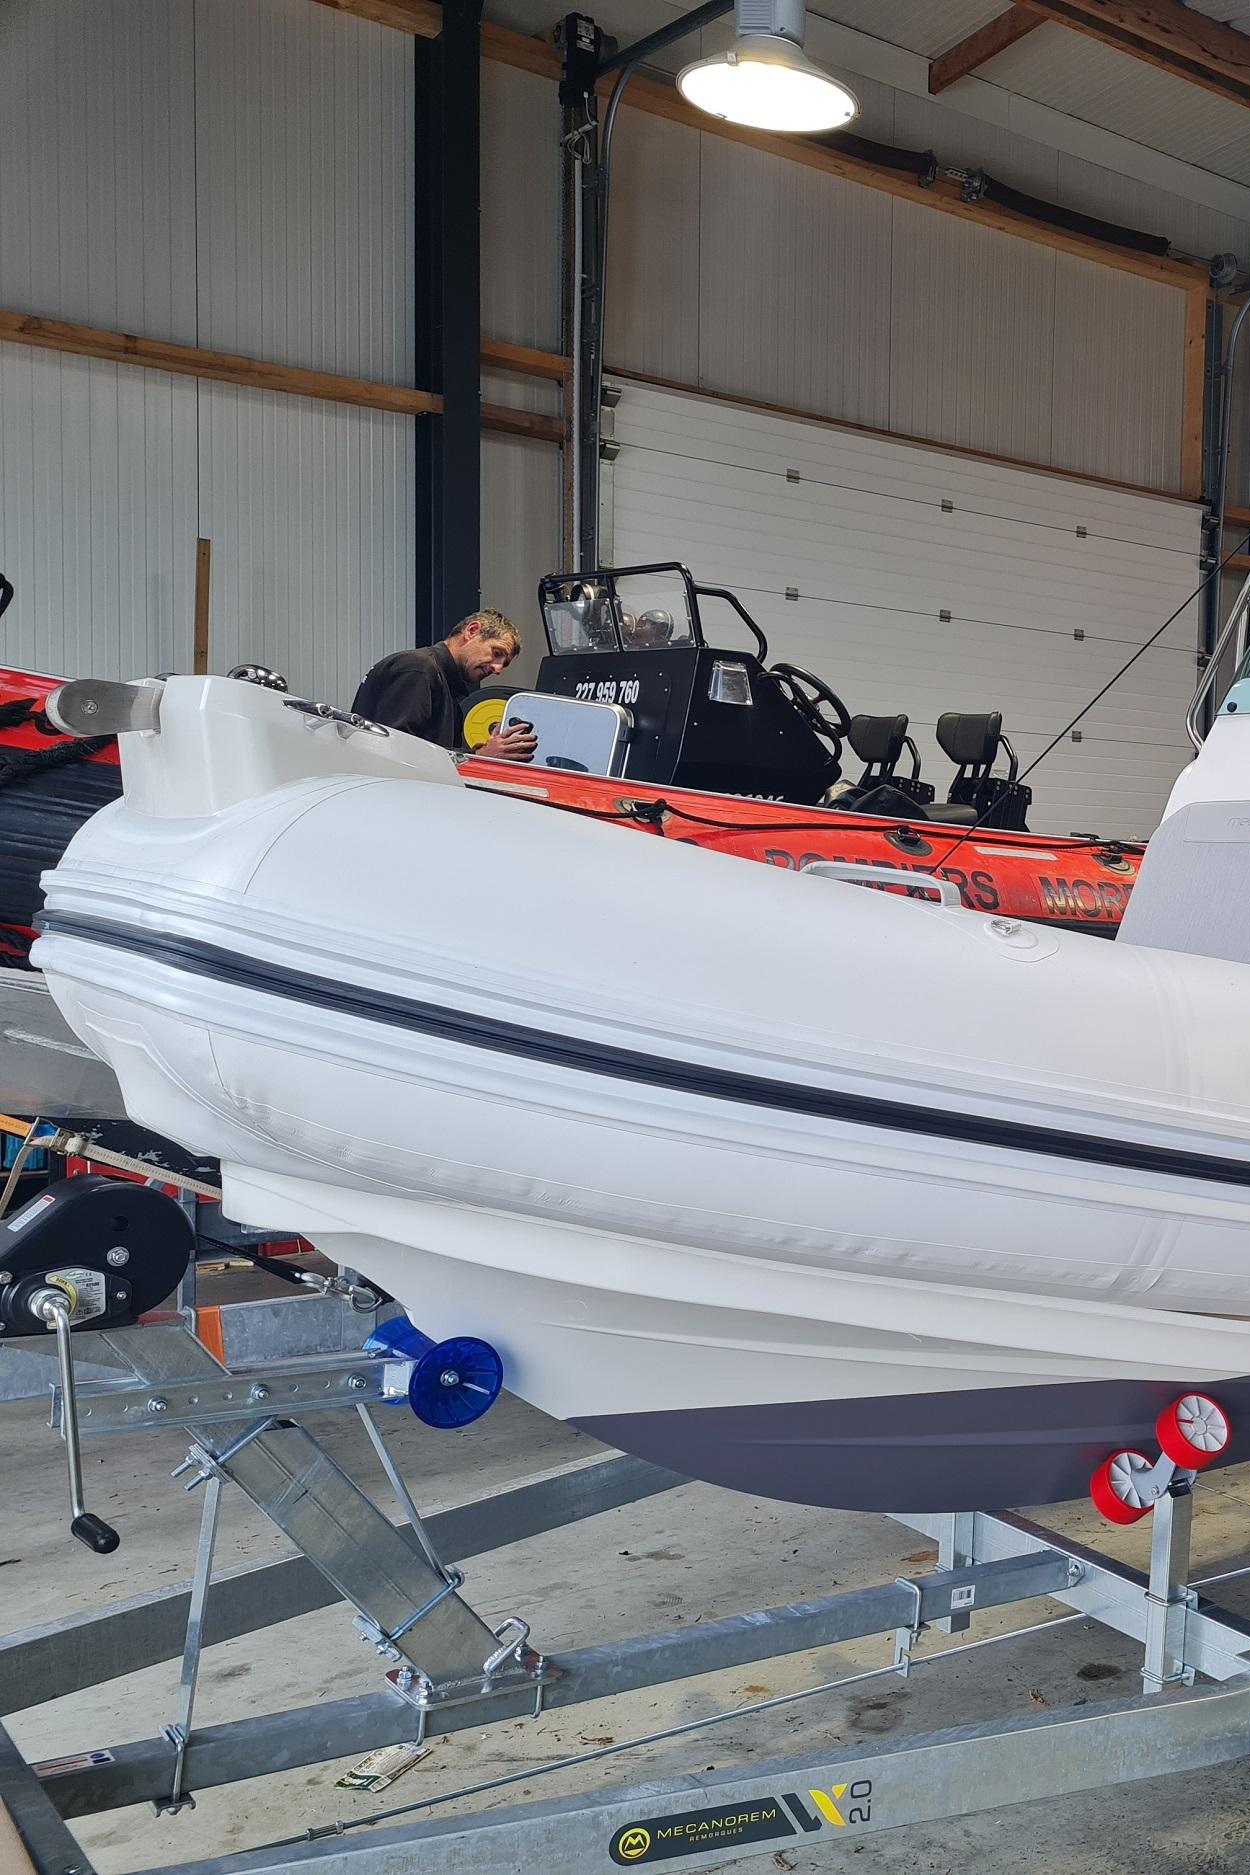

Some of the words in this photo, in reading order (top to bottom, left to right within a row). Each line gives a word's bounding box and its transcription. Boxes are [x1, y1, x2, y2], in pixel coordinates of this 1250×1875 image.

[575, 682, 596, 700] 227
[618, 680, 640, 704] 760
[848, 1779, 873, 1825] 2.0
[657, 1808, 776, 1839] MECANOREM
[689, 1827, 743, 1842] REMORQUES
